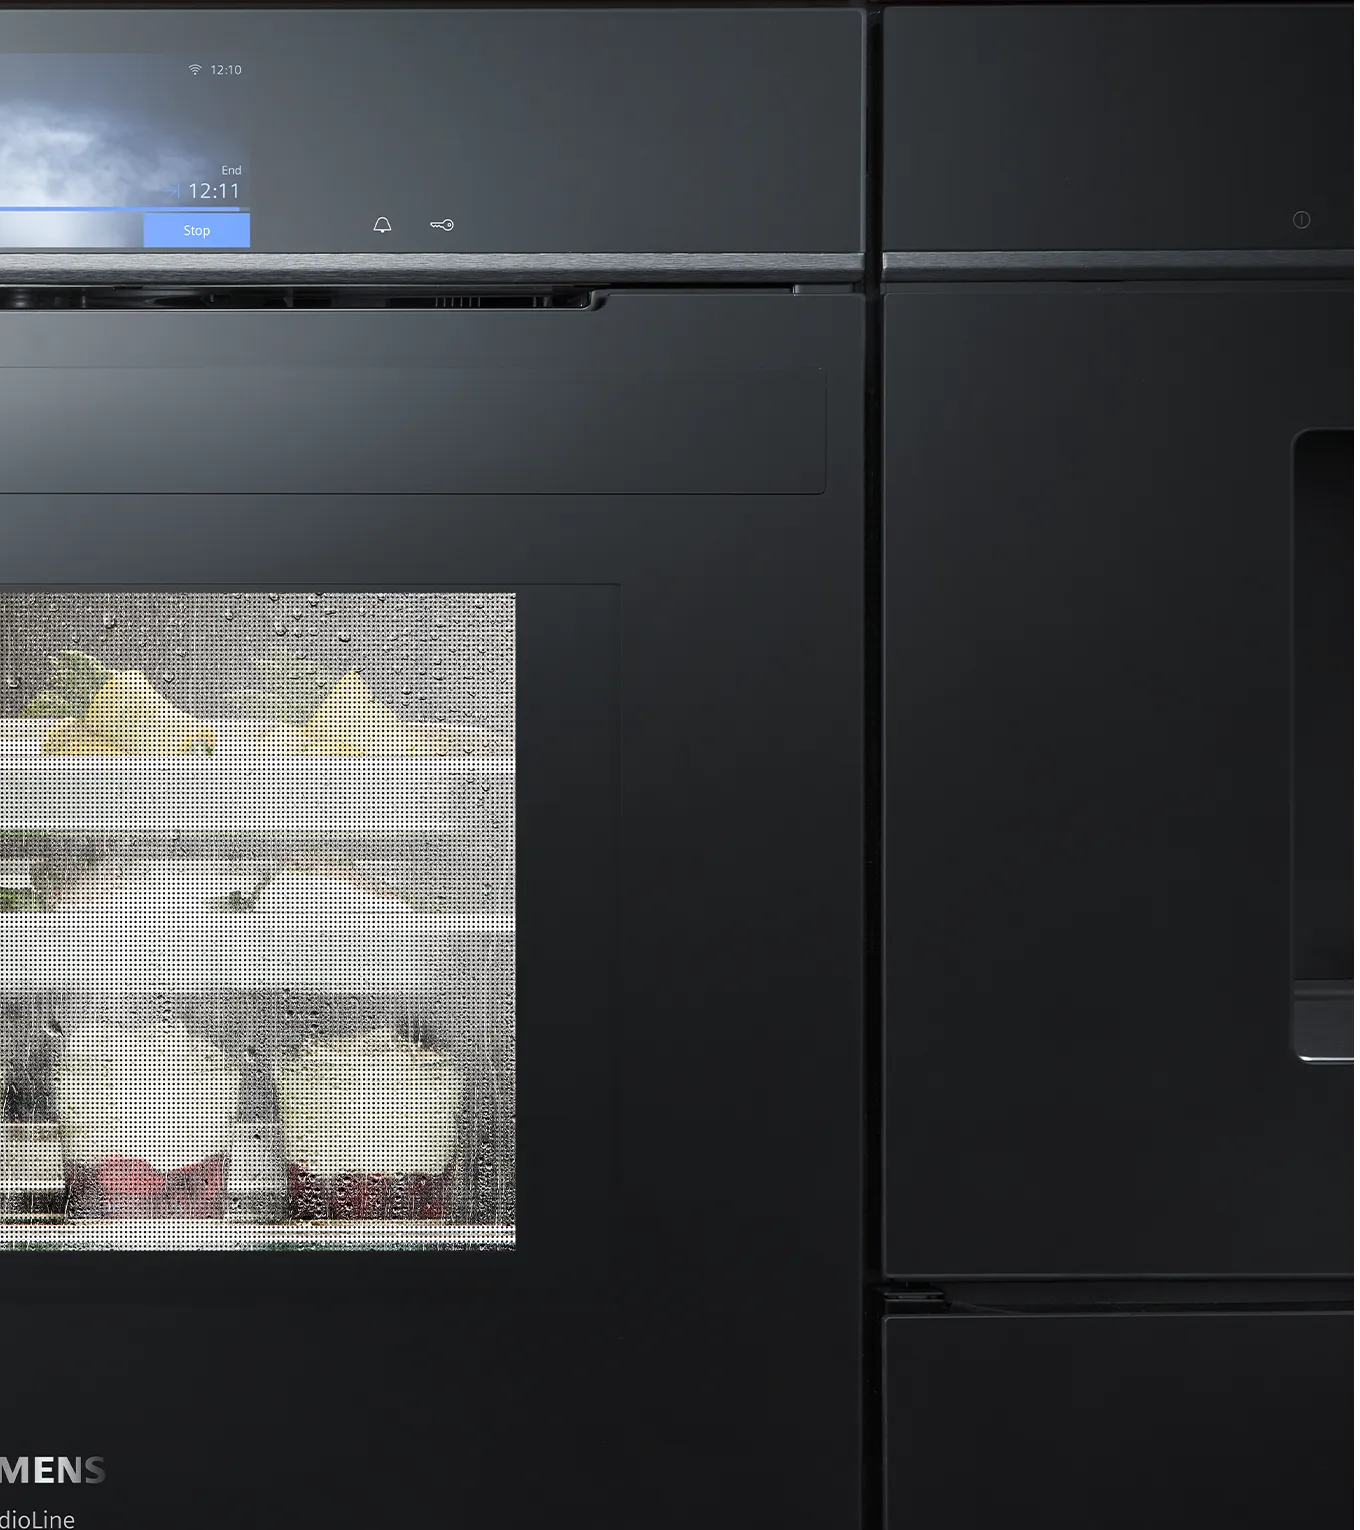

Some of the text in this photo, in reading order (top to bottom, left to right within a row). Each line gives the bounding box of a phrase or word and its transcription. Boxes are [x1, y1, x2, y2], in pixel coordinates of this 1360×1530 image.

[211, 64, 242, 75] 12:10
[221, 165, 242, 176] End
[189, 182, 239, 199] 12:11
[183, 224, 211, 239] Stop
